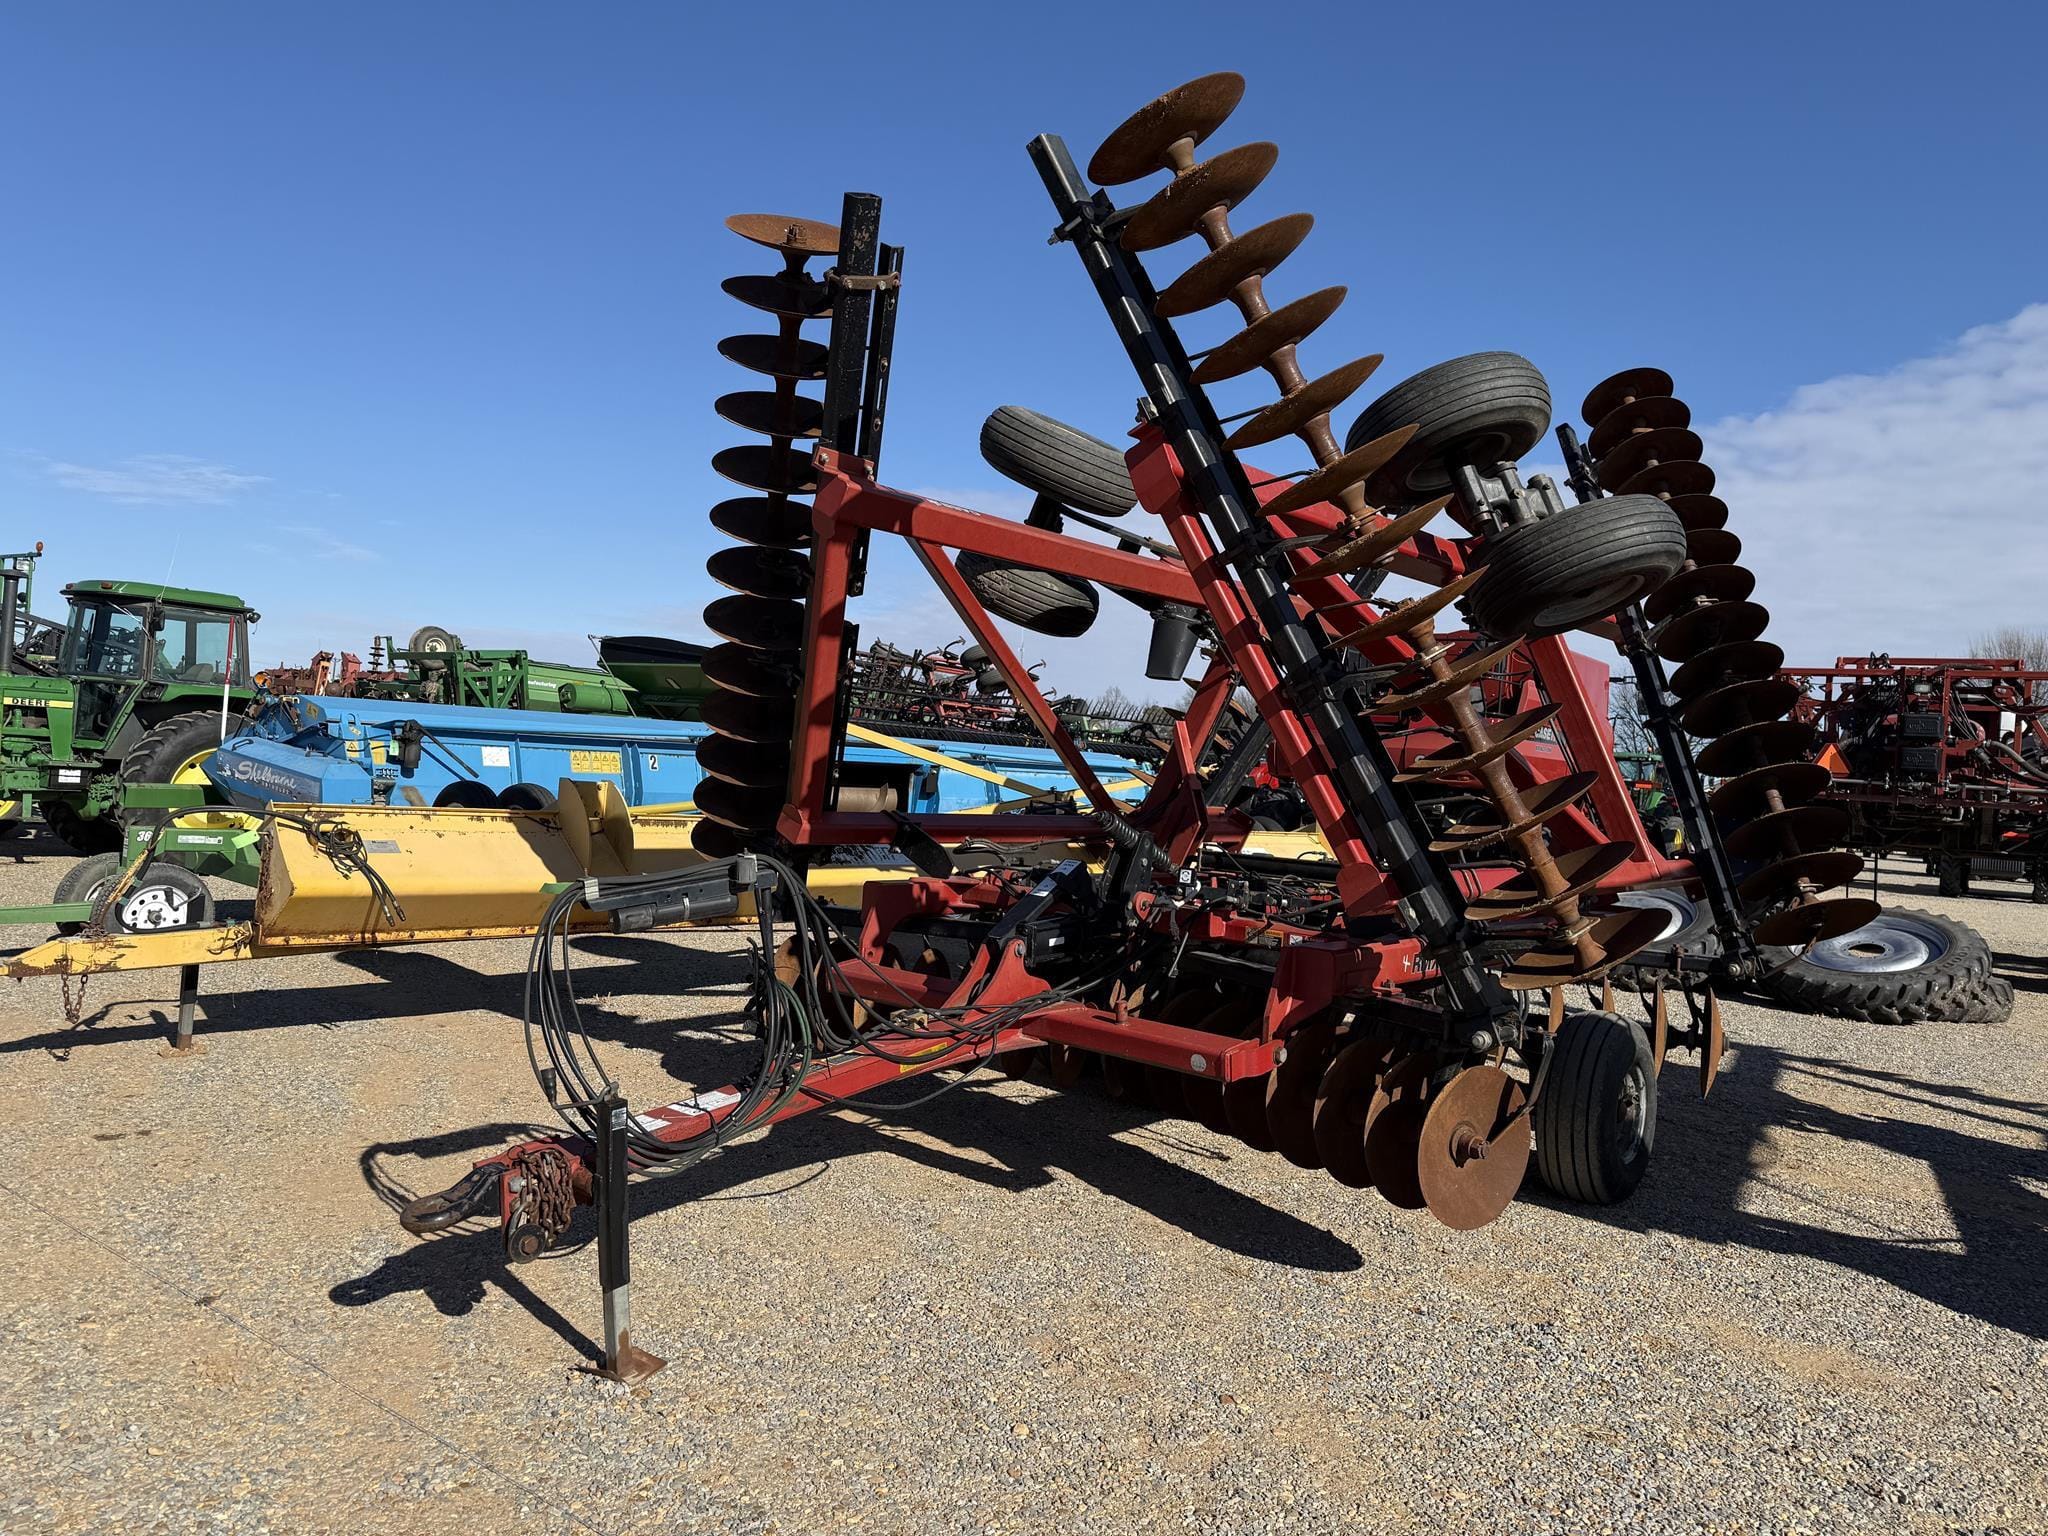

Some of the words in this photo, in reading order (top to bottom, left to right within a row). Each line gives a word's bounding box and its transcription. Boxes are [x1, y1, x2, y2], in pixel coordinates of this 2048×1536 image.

[12, 697, 50, 707] DEERE
[650, 755, 658, 770] 2
[233, 761, 297, 789] Shelbourne
